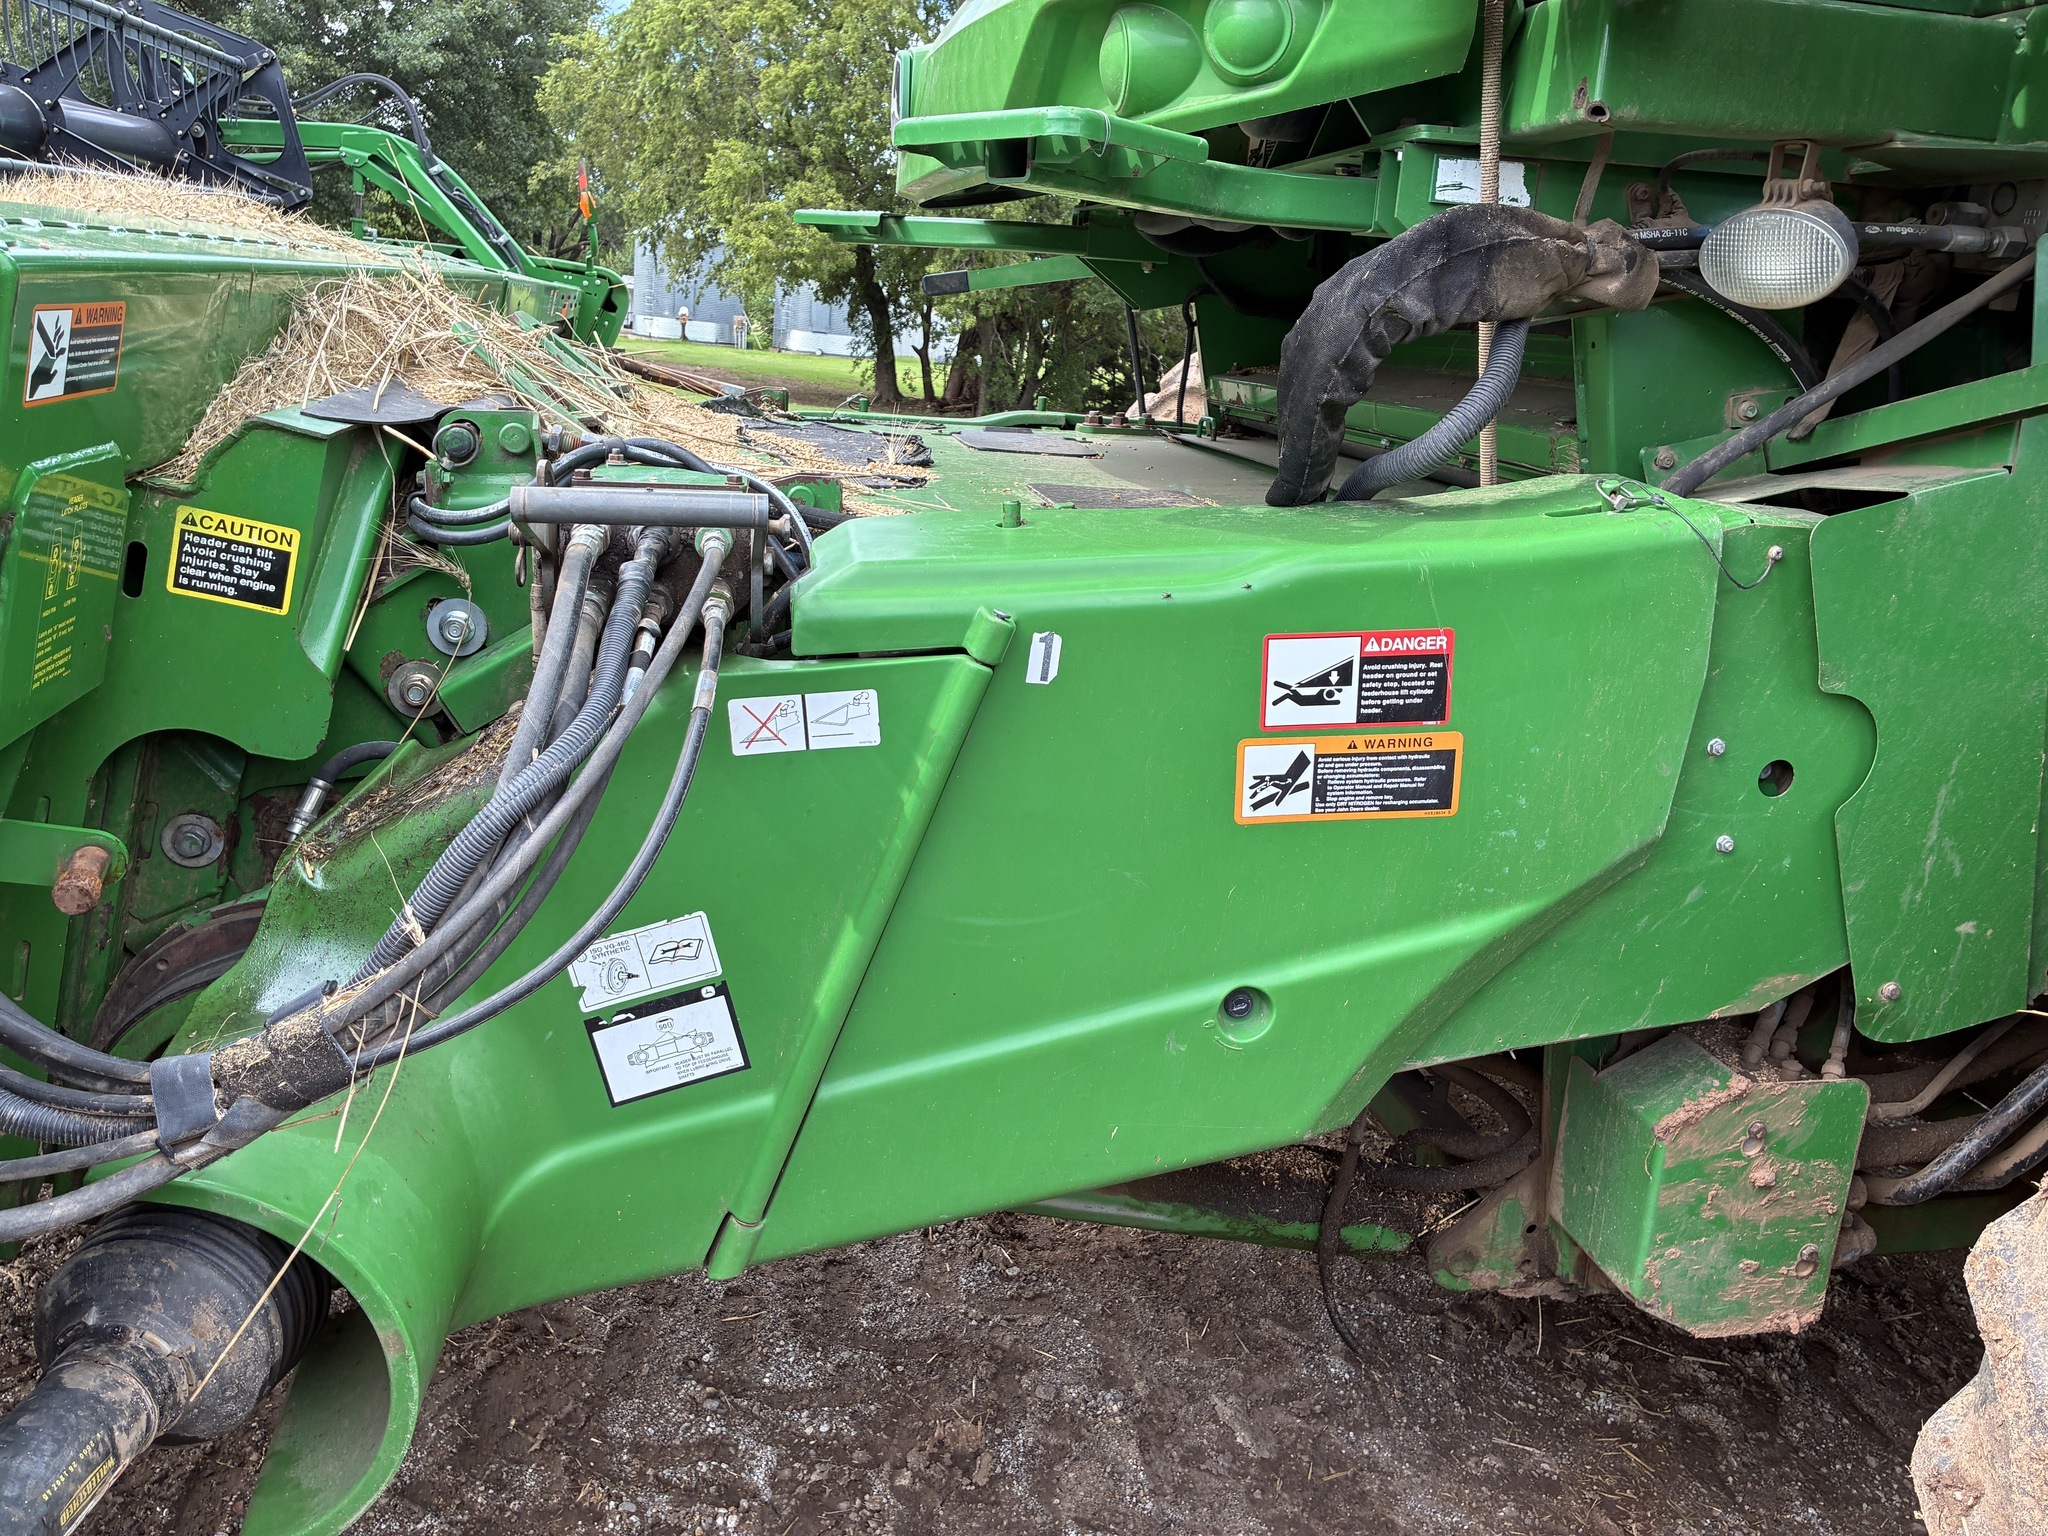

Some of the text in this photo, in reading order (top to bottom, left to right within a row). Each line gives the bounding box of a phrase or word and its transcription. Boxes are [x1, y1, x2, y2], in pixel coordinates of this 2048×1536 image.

[1640, 230, 1660, 239] MSHA
[86, 307, 123, 323] WARNING
[200, 515, 293, 547] CAUTION
[184, 532, 276, 559] Header can tilt.
[183, 543, 271, 571] Avoid crushing
[182, 554, 259, 579] injuries. Stay
[179, 575, 238, 596] is running.
[180, 565, 276, 592] clear when engine
[1381, 636, 1447, 651] DANGER
[1039, 632, 1054, 681] 1
[1382, 663, 1407, 671] crushing
[1409, 662, 1427, 670] injury.
[1384, 681, 1400, 689] stop,
[1382, 698, 1404, 706] getting
[1364, 737, 1433, 749] WARNING
[592, 945, 631, 960] SYNTHETIC
